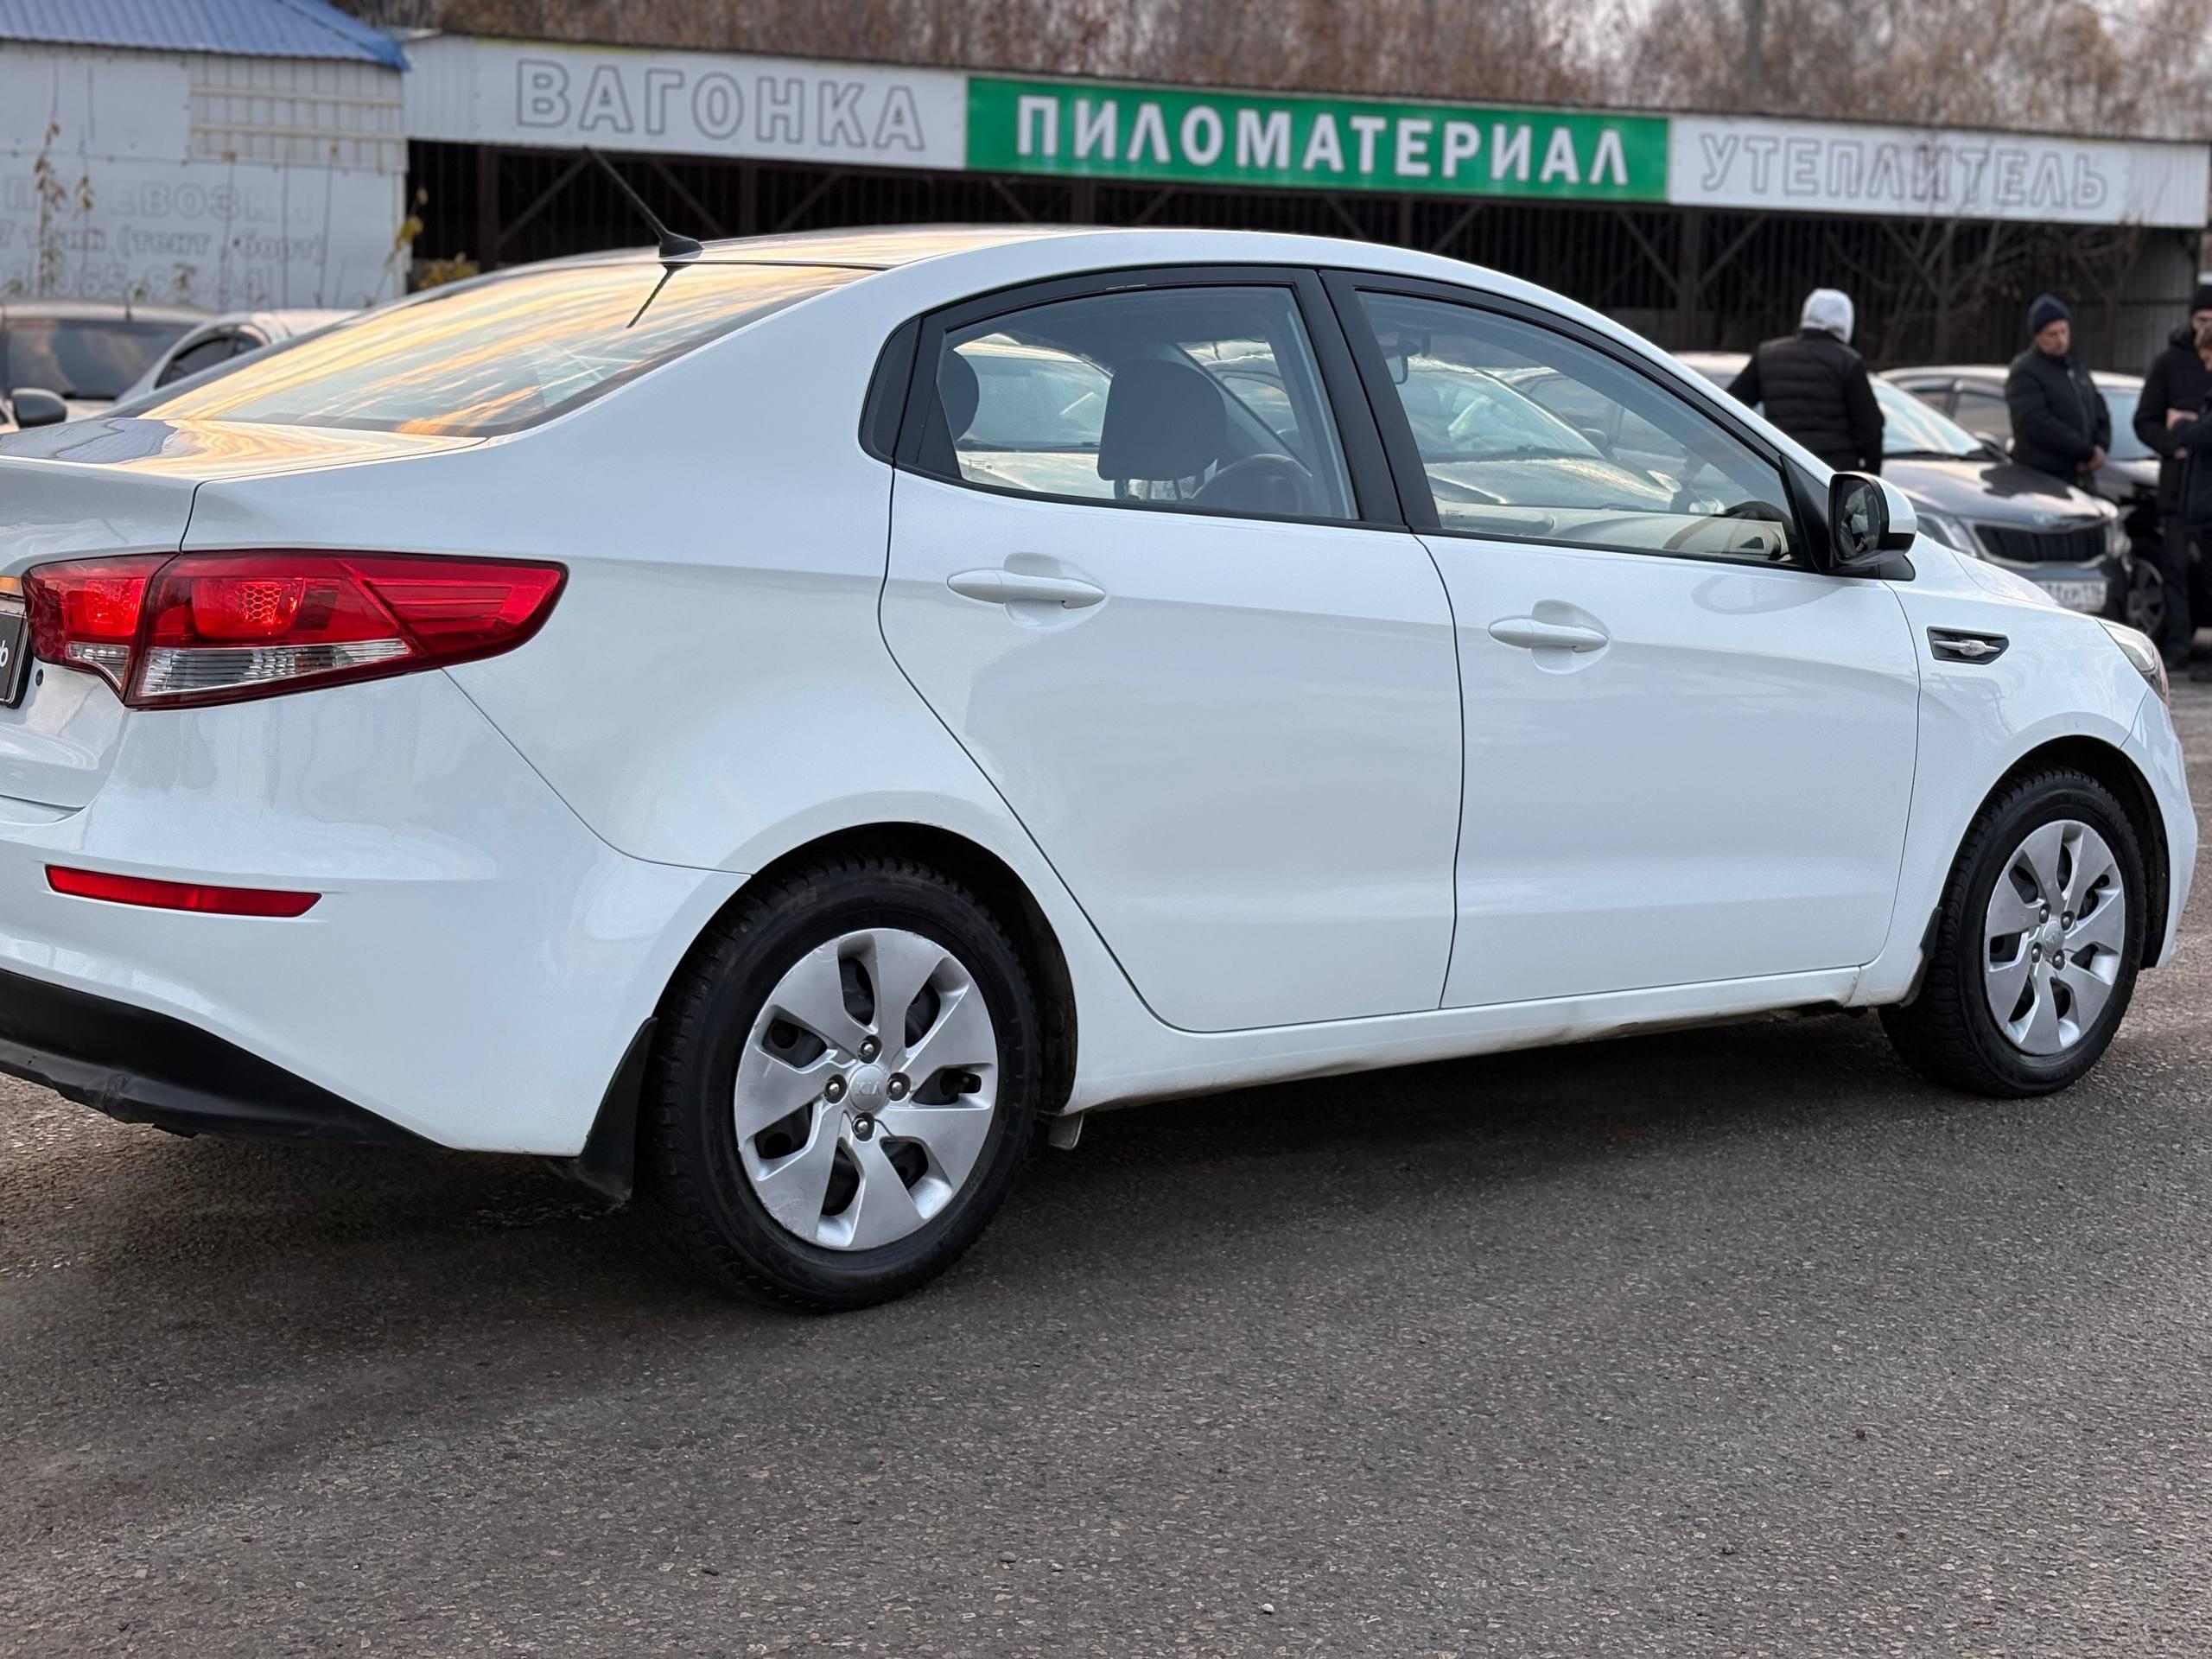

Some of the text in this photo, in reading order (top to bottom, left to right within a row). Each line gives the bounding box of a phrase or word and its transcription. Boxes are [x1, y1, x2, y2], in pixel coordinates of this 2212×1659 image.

[517, 59, 925, 152] ВАГОНКА
[1015, 94, 1630, 186] ПИЛОМАТЕРИАЛ
[1700, 132, 2108, 210] УТЕПЛИТЕЛЬ
